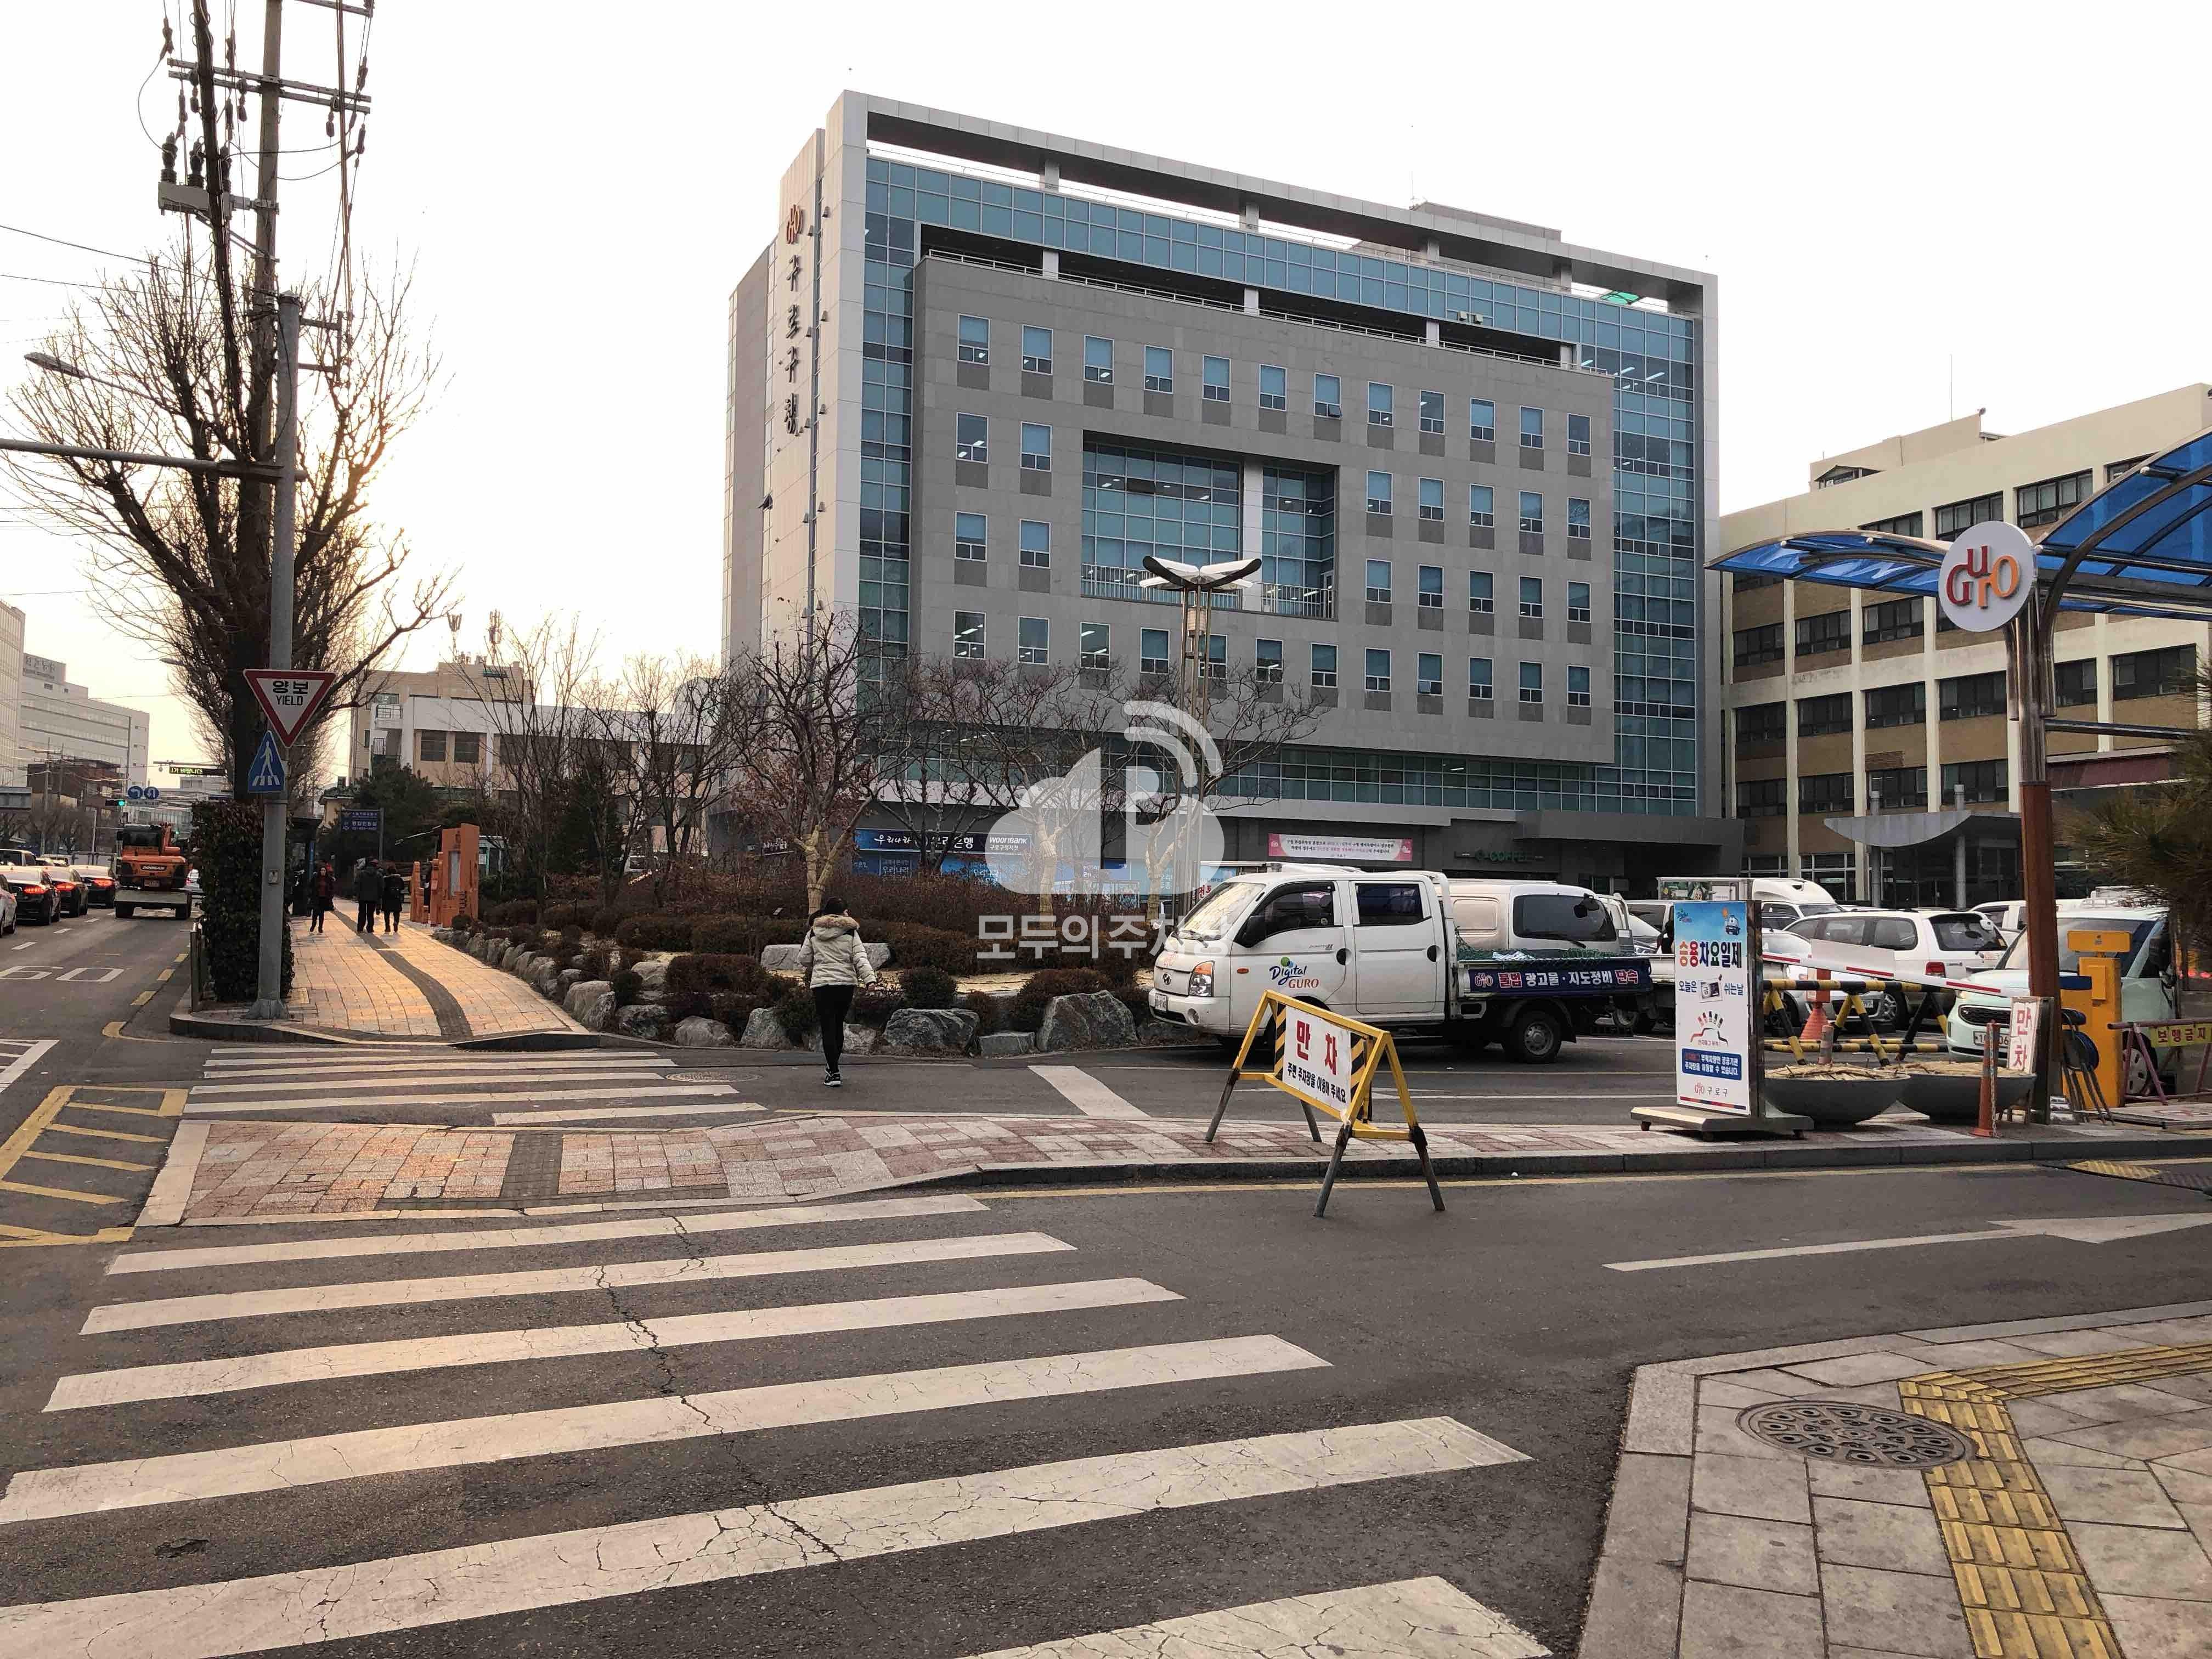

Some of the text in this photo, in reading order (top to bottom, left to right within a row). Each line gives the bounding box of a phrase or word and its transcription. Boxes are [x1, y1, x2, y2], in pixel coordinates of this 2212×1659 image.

[785, 254, 803, 436] 구로구청
[273, 680, 309, 695] 양보
[276, 695, 303, 706] YIELD
[874, 833, 912, 846] 우리나라
[1679, 941, 1742, 968] 승용차요일제
[0, 966, 125, 982] 60
[1269, 965, 1307, 985] Digital
[1525, 973, 1559, 986] 광고물
[1568, 970, 1613, 985] 지도정비
[1614, 969, 1638, 985] 단속
[1288, 979, 1319, 989] GURO
[1679, 980, 1697, 992] 오늘은
[1724, 983, 1744, 996] 쉬는날
[2158, 1027, 2206, 1043] 보행금지
[1715, 1065, 1719, 1074] 수
[1288, 1062, 1297, 1079] 주변
[1298, 1066, 1317, 1088] 주차장을
[1330, 1084, 1347, 1103] 주세요
[1707, 1086, 1728, 1097] 구로구
